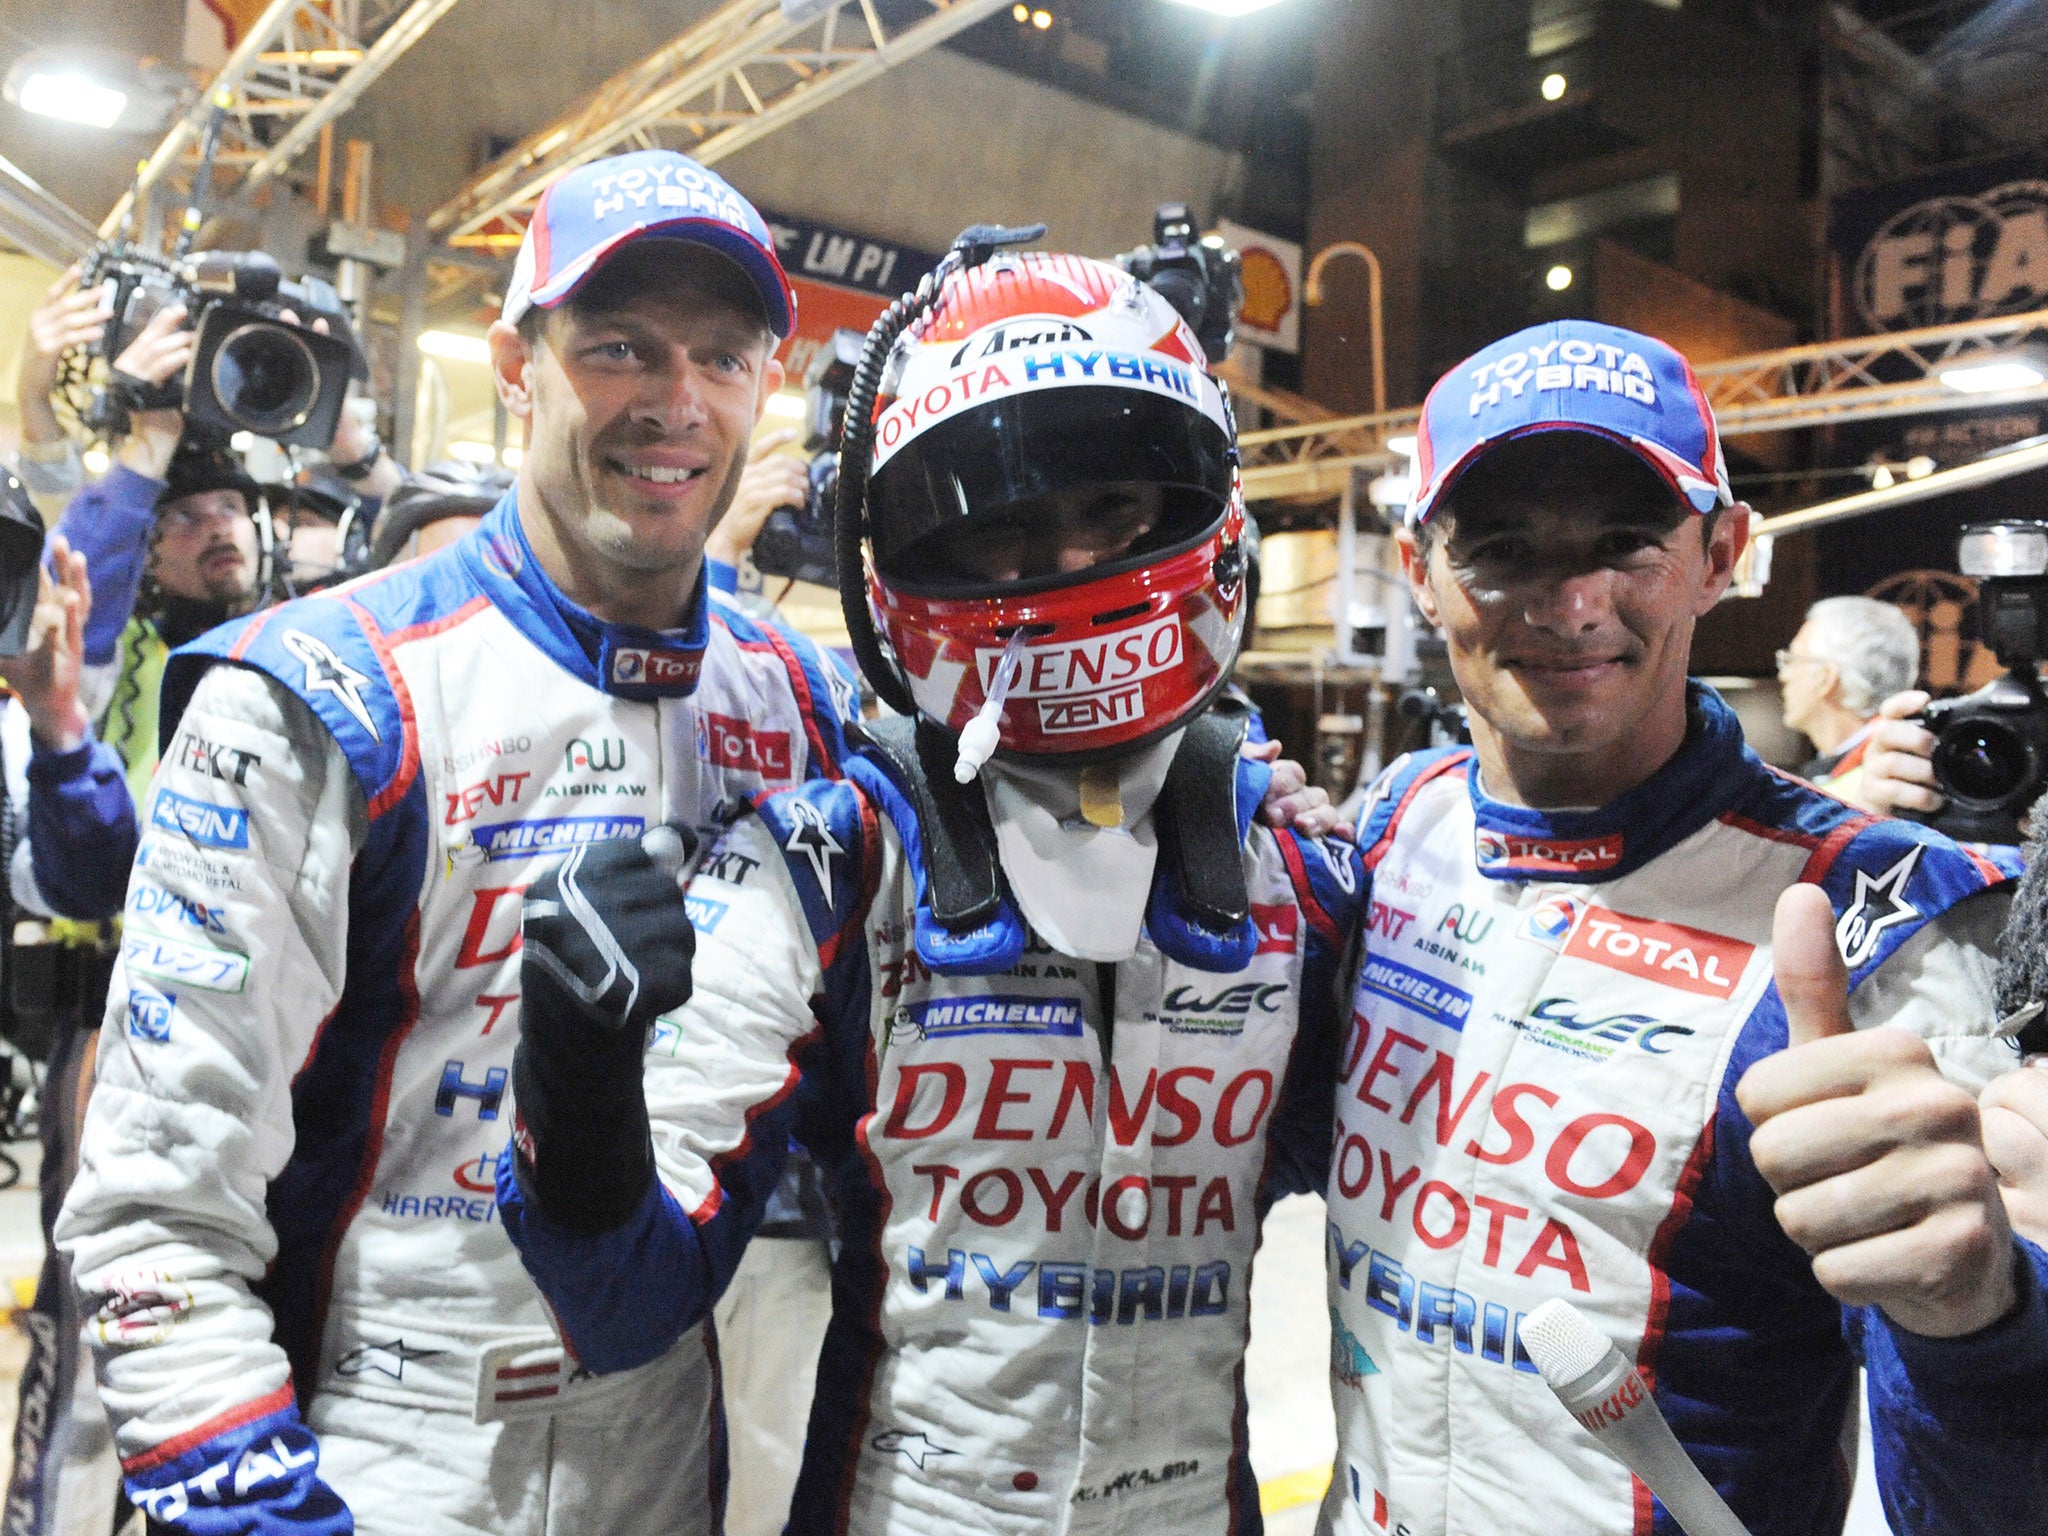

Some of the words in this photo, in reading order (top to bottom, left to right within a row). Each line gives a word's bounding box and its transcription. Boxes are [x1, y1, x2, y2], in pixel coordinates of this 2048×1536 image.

[592, 164, 744, 219] TOYOTA
[593, 184, 751, 232] HYBRID
[951, 320, 1094, 368] Arai
[1469, 338, 1655, 386] TOYOTA
[1468, 363, 1656, 417] HYBRID
[984, 622, 1180, 693] DENSO
[1041, 687, 1140, 730] ZENT
[445, 770, 531, 826] ZENT
[545, 784, 607, 798] AISIN
[616, 784, 647, 797] AW
[490, 821, 643, 849] MICHELIN
[1511, 840, 1617, 864] TOTAL
[1413, 938, 1458, 963] AISIN
[1588, 918, 1730, 988] TOTAL
[924, 1003, 1078, 1027] MICHELIN
[1163, 982, 1289, 1013] WEC
[1362, 961, 1472, 1020] MICHELIN
[1530, 997, 1696, 1054] WEC
[884, 1058, 1274, 1148] DENSO
[912, 1164, 1236, 1242] TOYOTA
[1334, 1118, 1590, 1293] OYOTA
[907, 1245, 1232, 1326] HYBRID
[1327, 1217, 1541, 1374] YBRI
